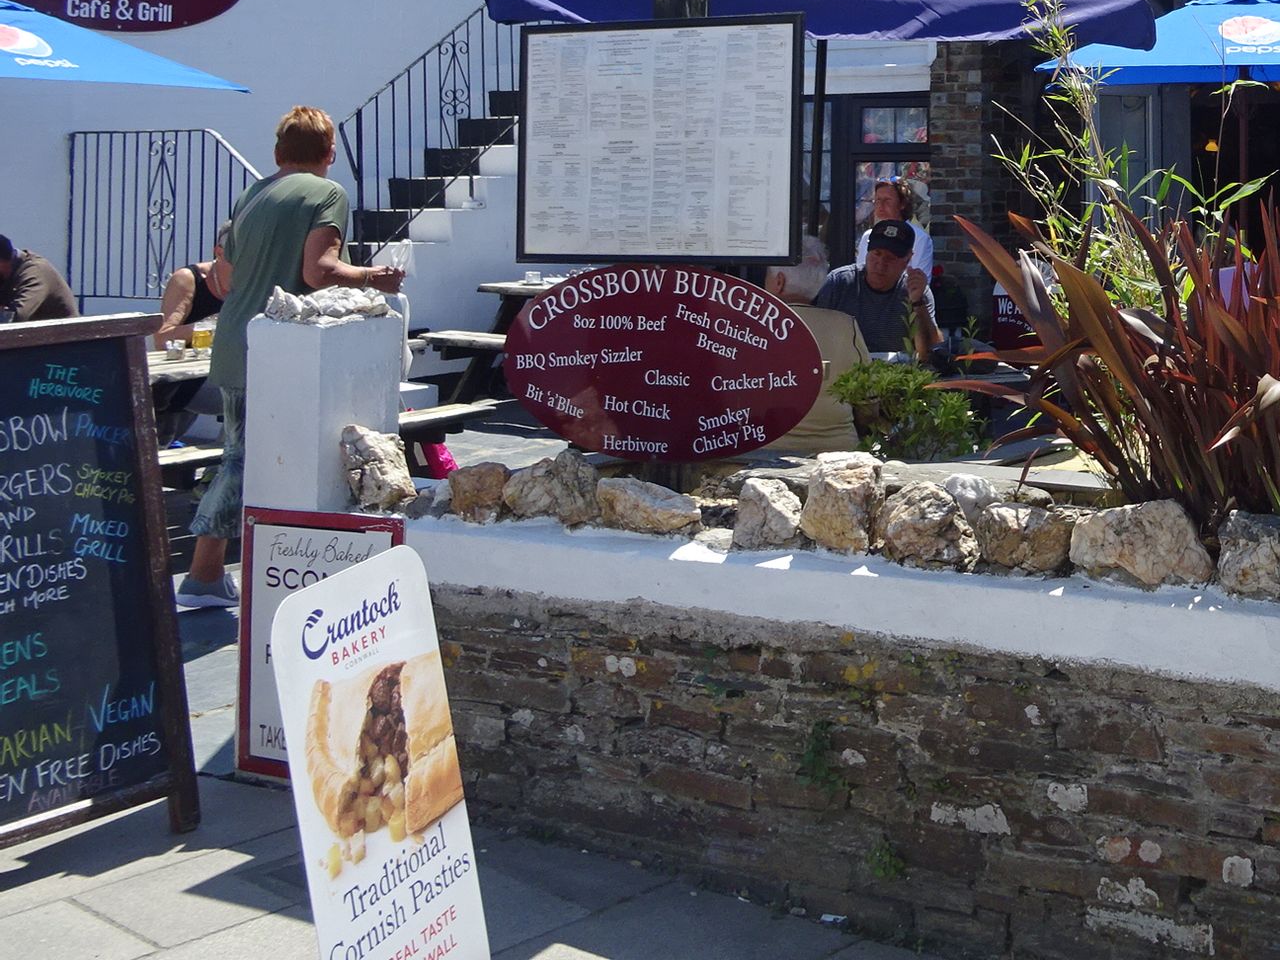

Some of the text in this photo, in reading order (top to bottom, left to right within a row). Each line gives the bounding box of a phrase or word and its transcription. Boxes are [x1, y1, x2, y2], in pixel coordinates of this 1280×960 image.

[138, 1, 173, 23] Grill
[528, 268, 795, 340] CROSSBOW BURGERS
[998, 297, 1013, 315] We
[573, 313, 667, 332] 8oz 100% Beef
[675, 302, 768, 350] Fresh Chicken
[516, 346, 643, 371] BBQ Smokey Sizzler
[696, 332, 738, 360] Breast
[45, 363, 80, 385] THE
[644, 369, 690, 386] Classic
[711, 370, 798, 391] Cracker Jack
[28, 378, 104, 404] HERBIVORE
[525, 383, 544, 403] Bit
[603, 394, 671, 420] Hot Chick
[698, 407, 751, 431] Smokey
[603, 435, 669, 453] Herbivore
[692, 424, 766, 454] Chicky Pig
[70, 512, 129, 538] MIXED
[73, 536, 128, 563] GRILL
[269, 532, 374, 567] Freshly Baked
[26, 557, 87, 589] DISHES
[23, 585, 71, 610] MORE
[302, 580, 402, 661] Crantock
[331, 625, 387, 666] BAKERY
[344, 649, 380, 670] CORNWALL
[89, 680, 156, 733] VEGAN
[35, 753, 93, 789] FREE
[100, 731, 162, 772] DISHES
[343, 821, 447, 922] Traditional
[329, 852, 471, 960] Cornish Pasties
[420, 904, 458, 944] TASTE
